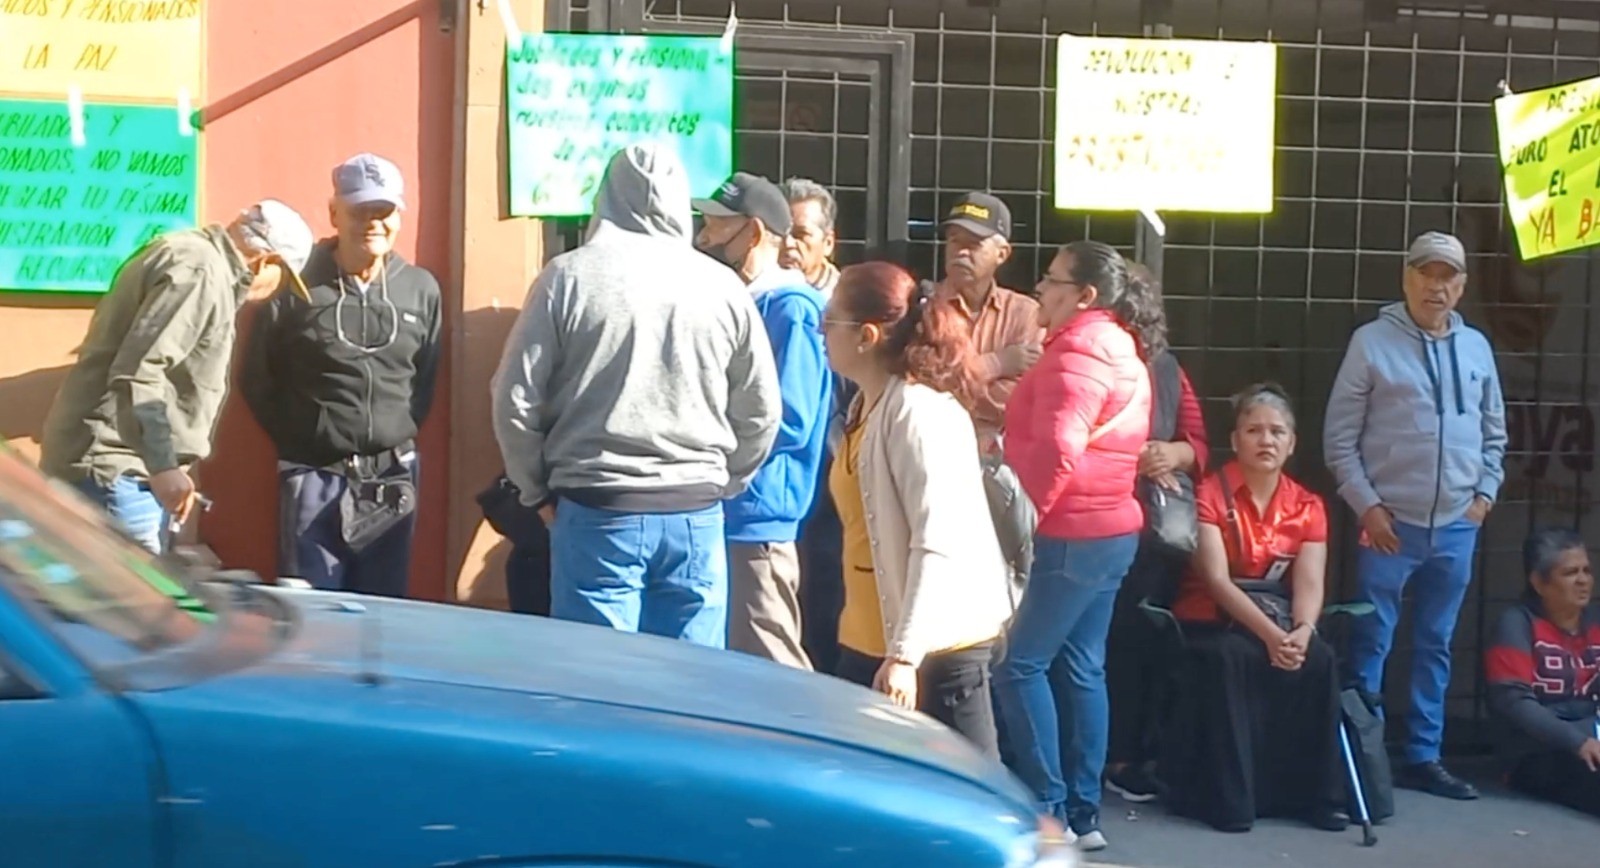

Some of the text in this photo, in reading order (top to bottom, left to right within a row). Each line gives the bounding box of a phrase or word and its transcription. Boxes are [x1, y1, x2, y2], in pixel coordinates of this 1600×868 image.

[23, 43, 50, 70] LA
[108, 114, 124, 137] Y
[91, 149, 121, 172] NO
[127, 150, 191, 177] VAMOS
[1548, 169, 1568, 198] EL
[1529, 205, 1558, 252] YA
